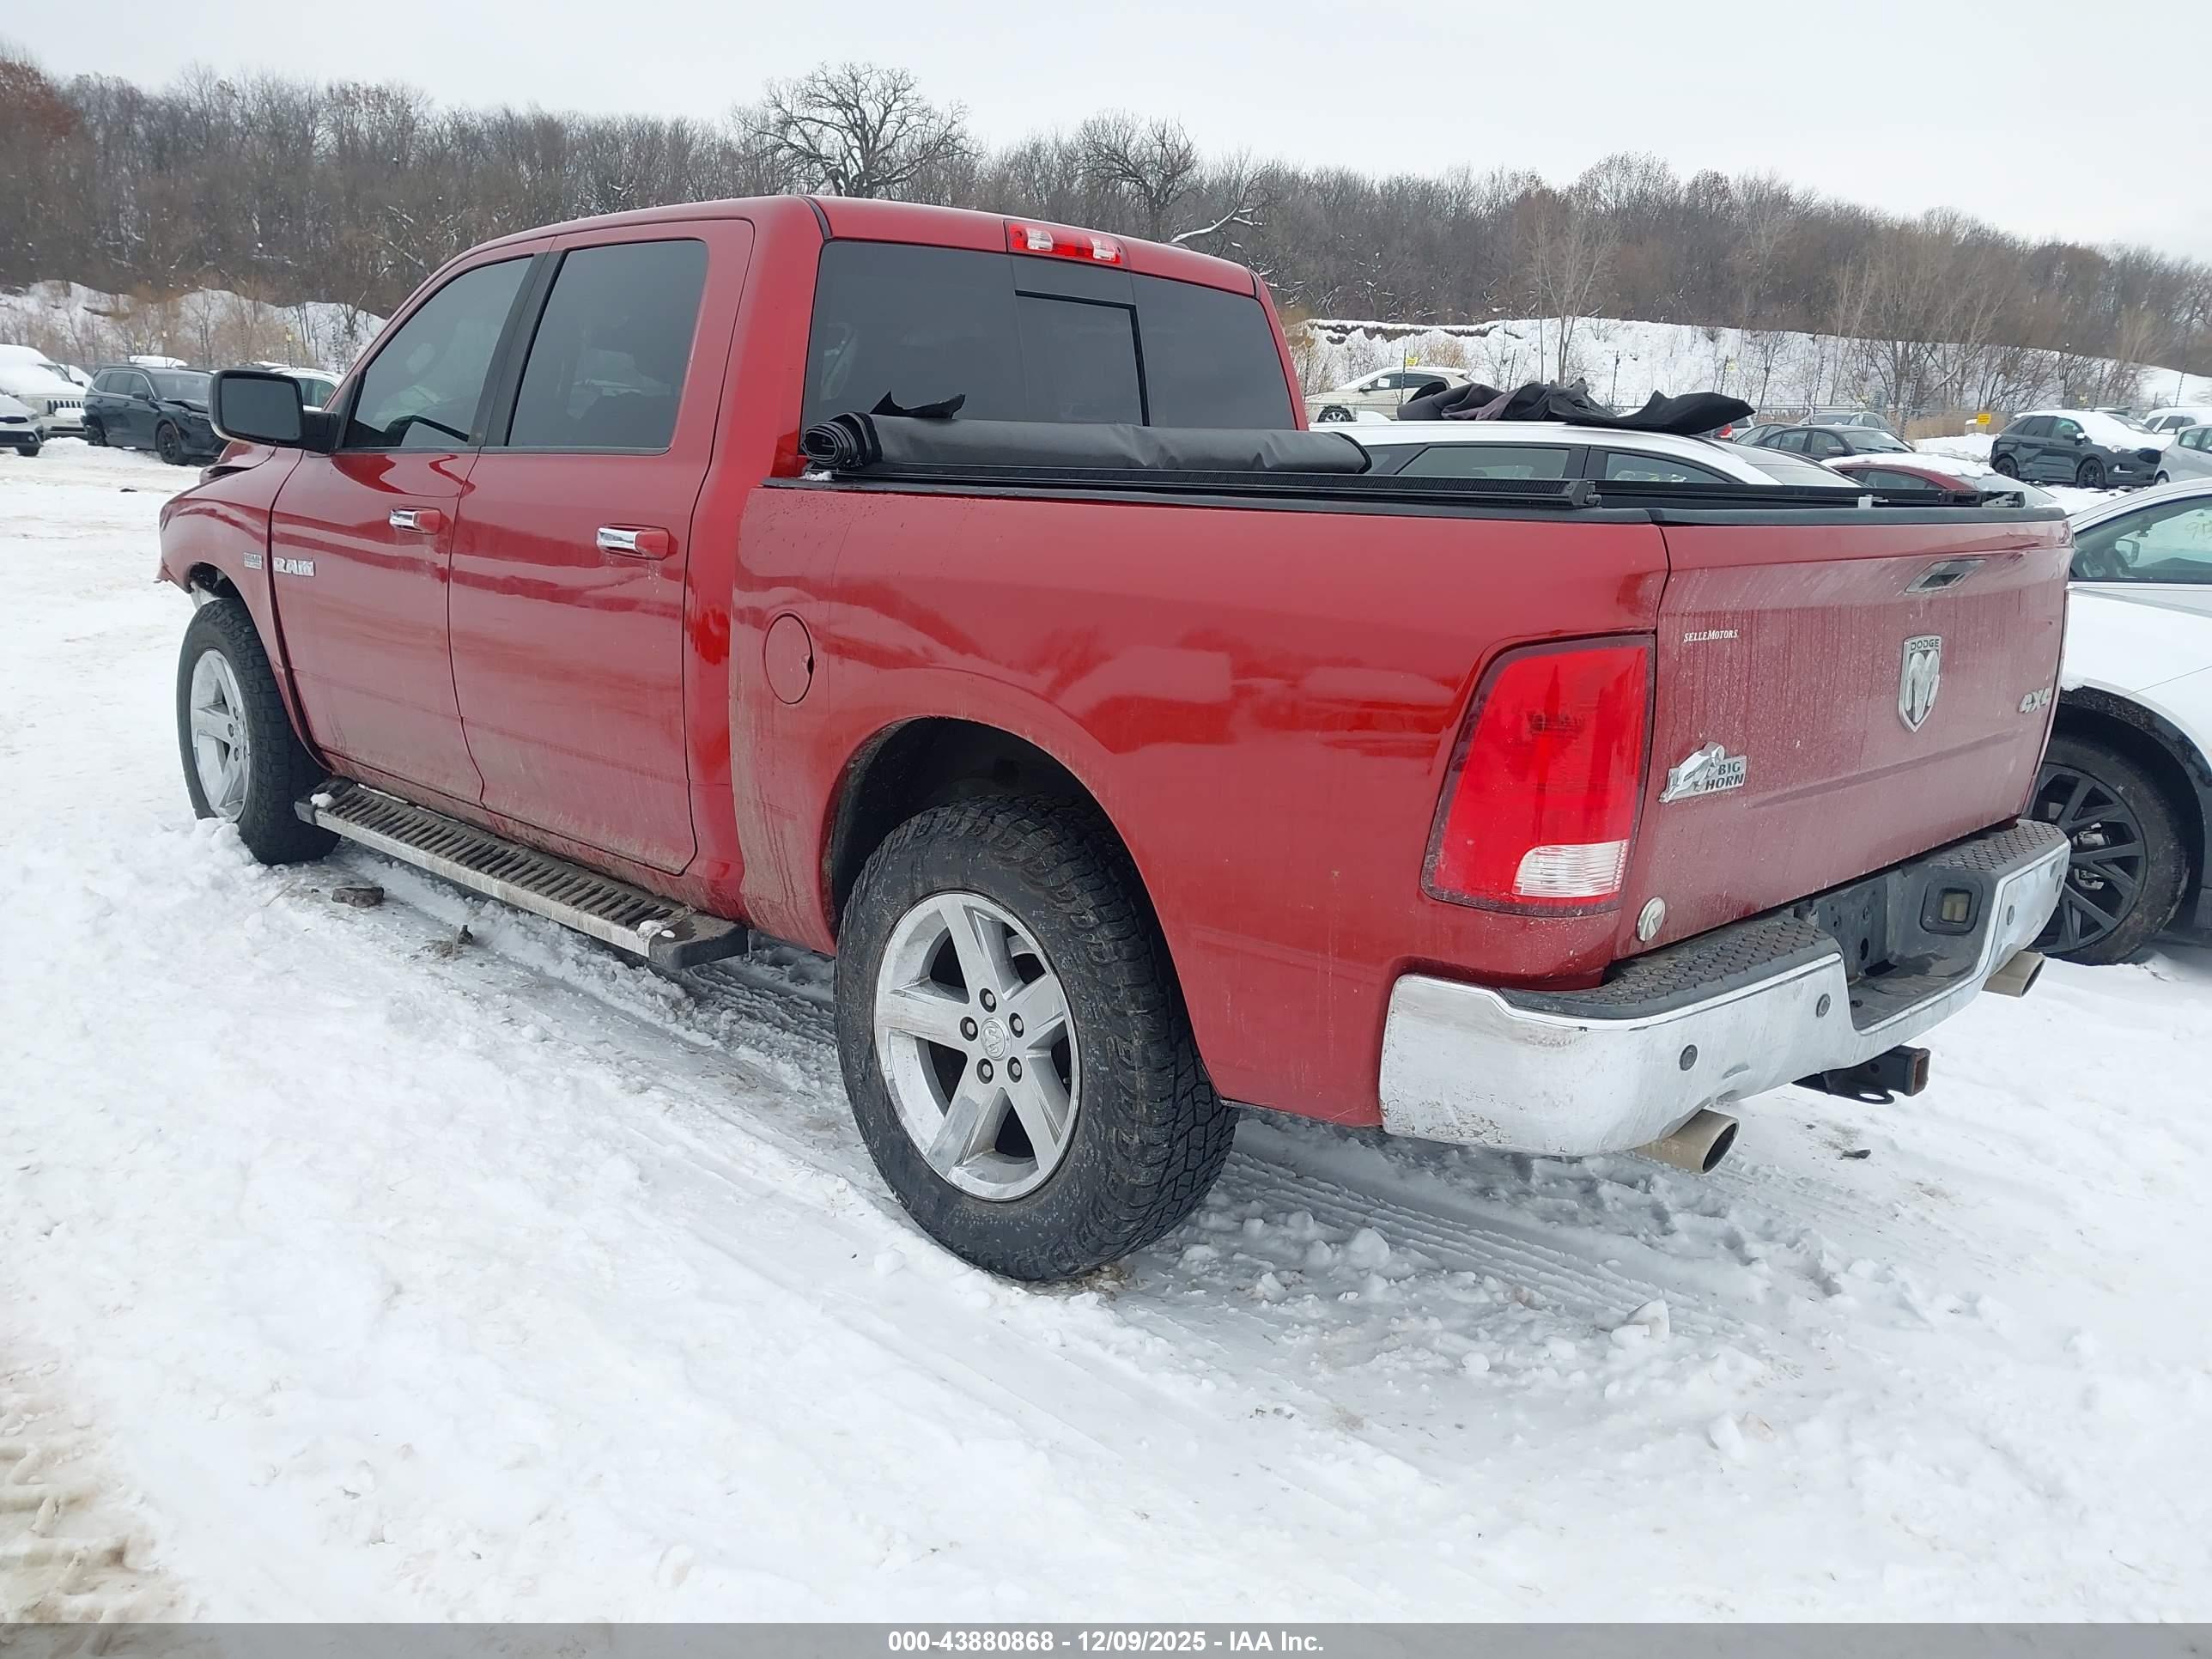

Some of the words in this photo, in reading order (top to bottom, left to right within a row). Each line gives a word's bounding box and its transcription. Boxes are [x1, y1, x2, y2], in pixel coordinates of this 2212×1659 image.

[274, 556, 314, 577] RAM
[1910, 638, 1940, 651] DODGE
[1718, 761, 1741, 775] BIG
[1705, 773, 1745, 791] HORN
